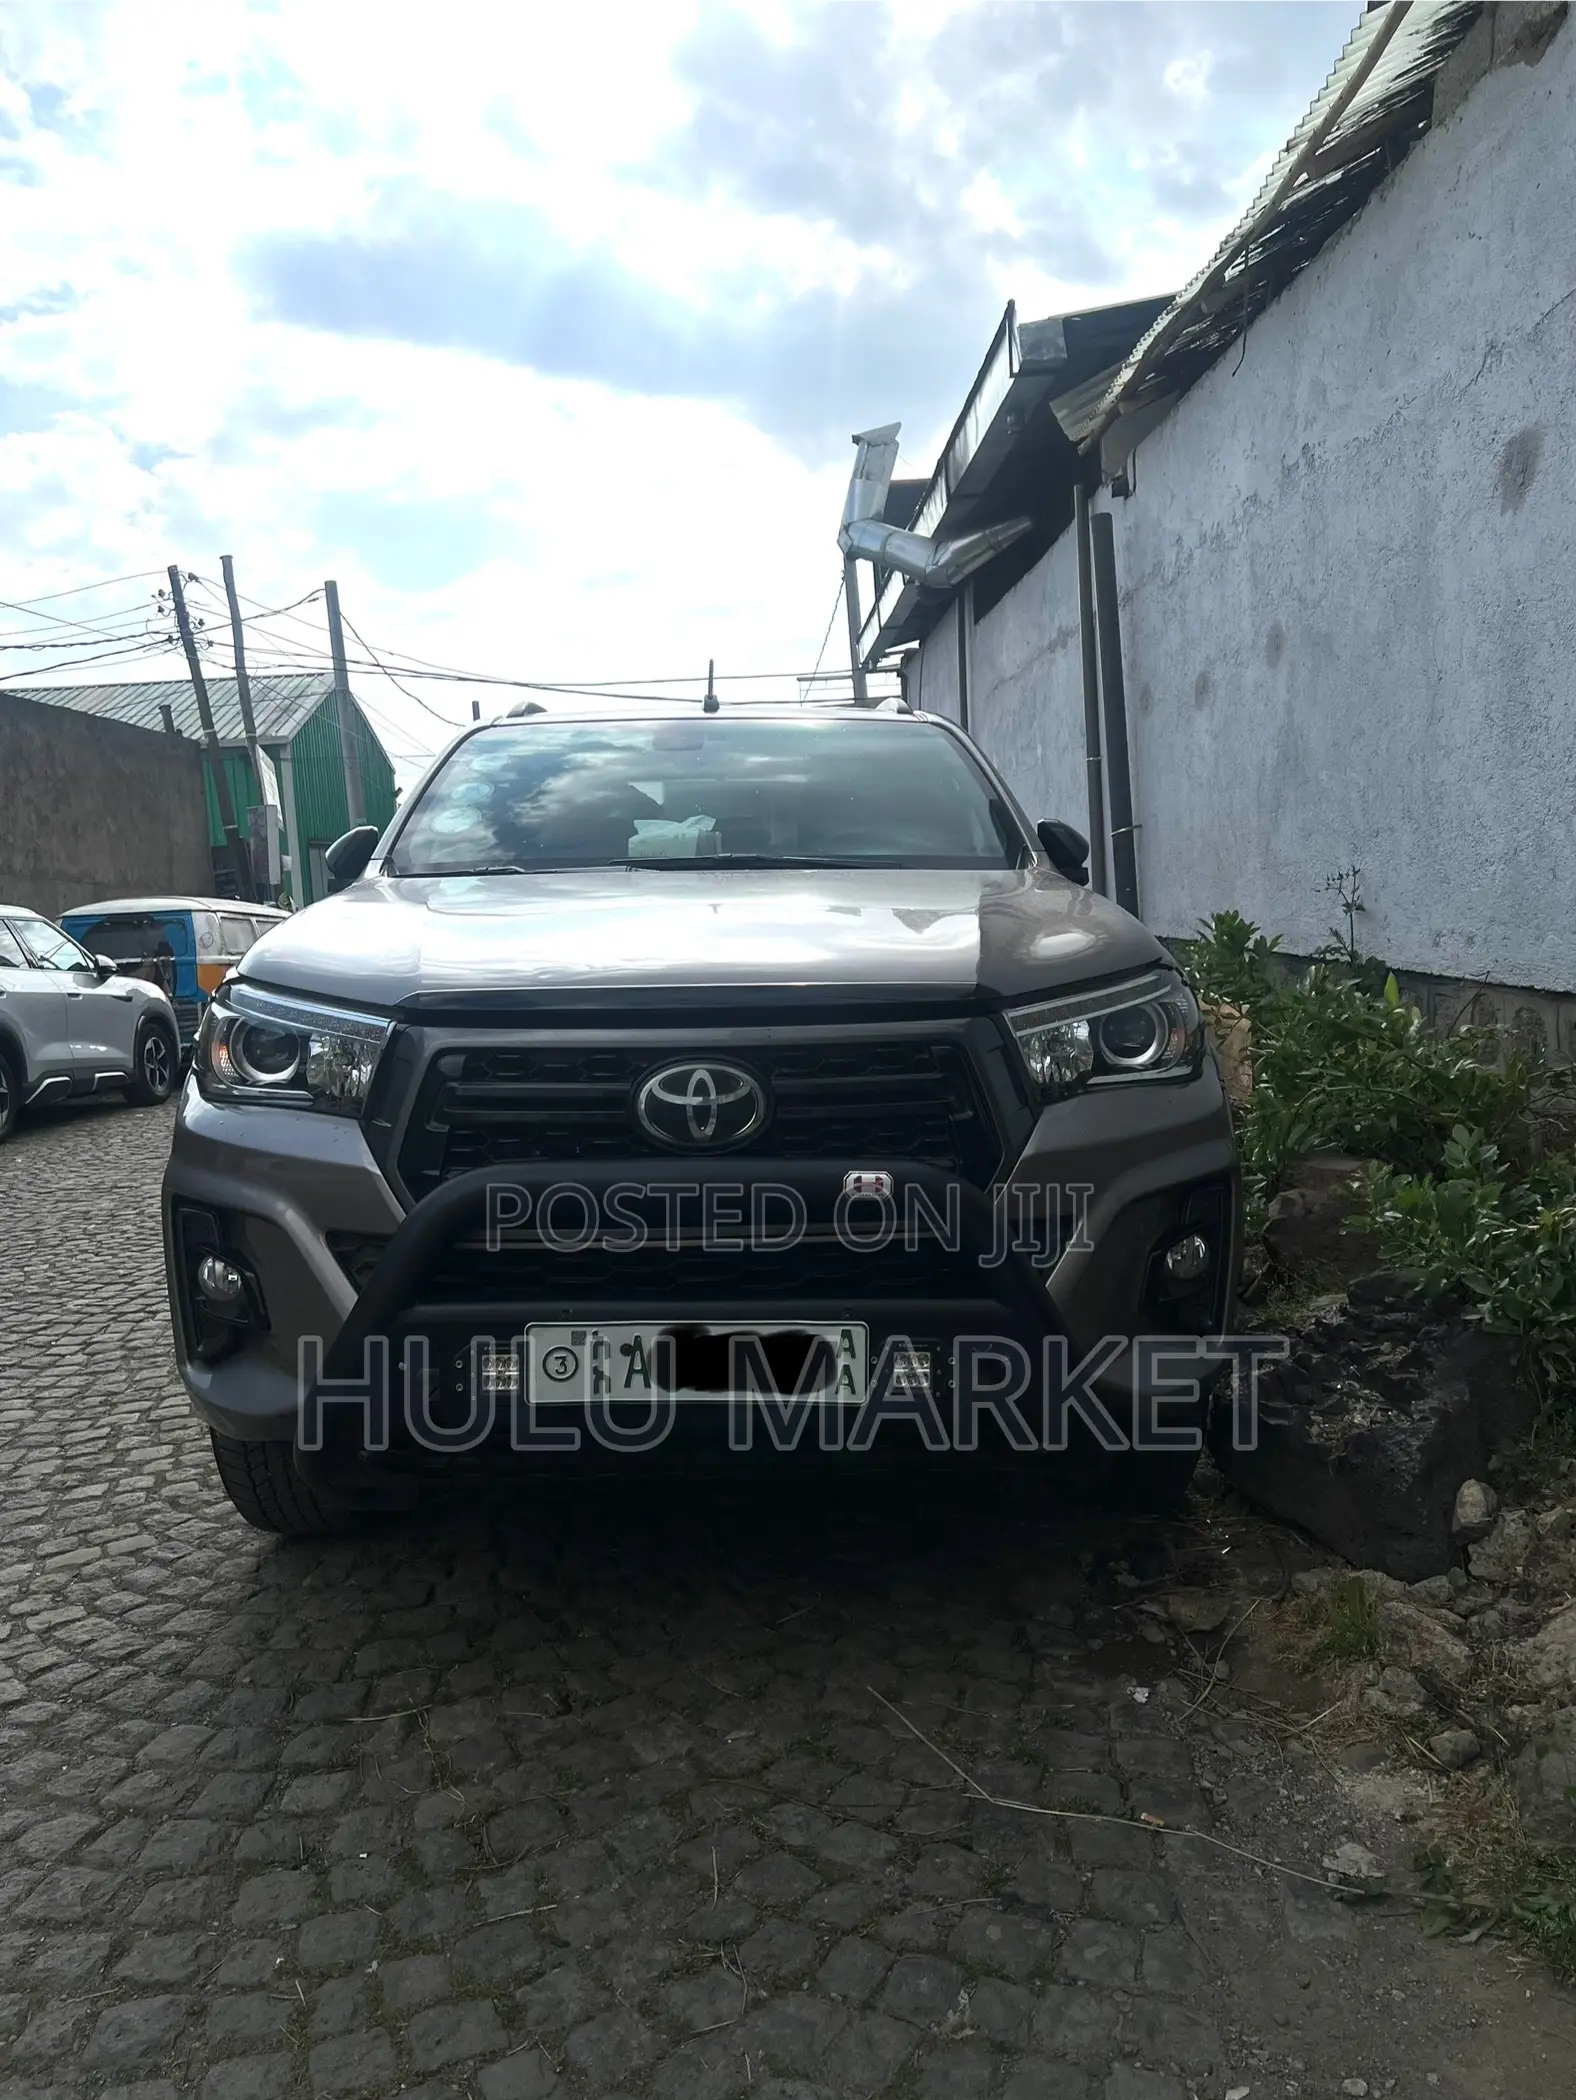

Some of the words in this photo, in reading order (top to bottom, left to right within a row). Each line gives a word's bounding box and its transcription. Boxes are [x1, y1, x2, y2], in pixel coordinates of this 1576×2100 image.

[835, 1328, 857, 1360] A
[623, 1333, 652, 1389] A
[834, 1363, 857, 1396] A
